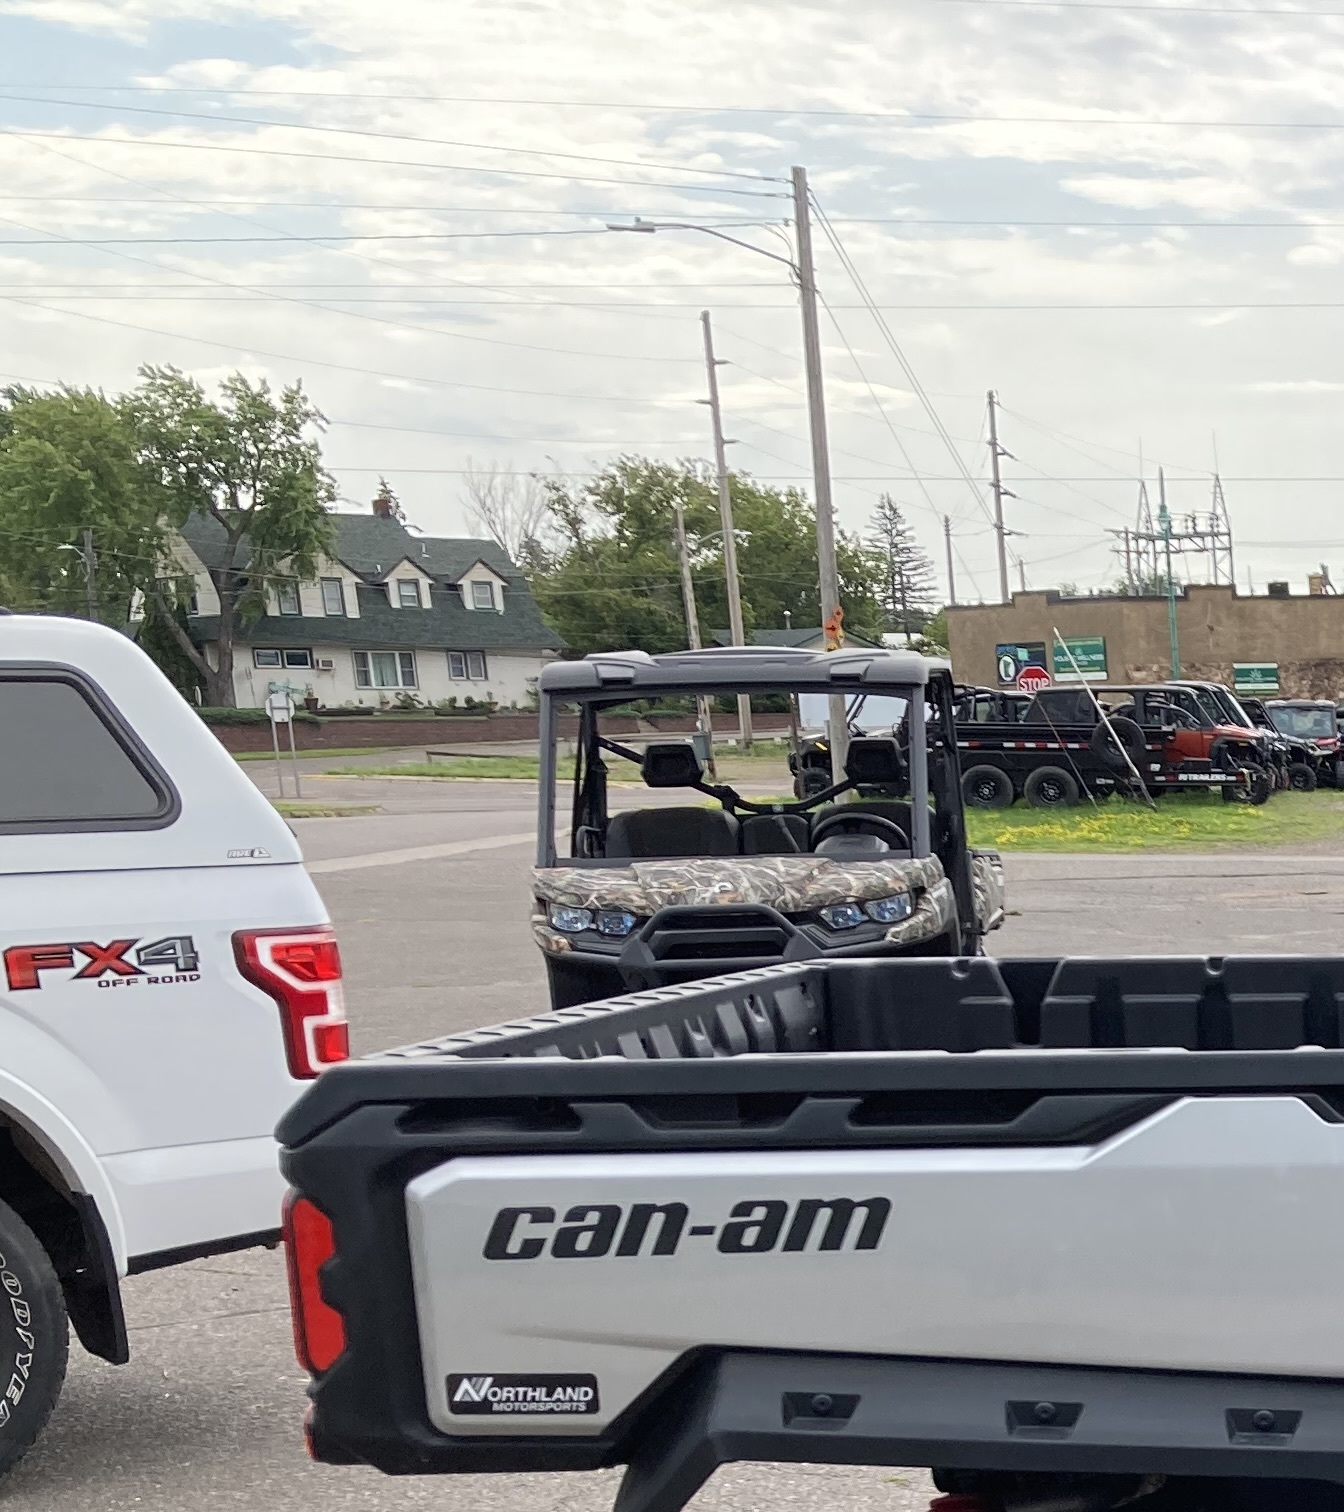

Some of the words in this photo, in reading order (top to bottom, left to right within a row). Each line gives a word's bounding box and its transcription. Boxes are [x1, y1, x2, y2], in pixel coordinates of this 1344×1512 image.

[1019, 677, 1049, 691] STOP
[3, 935, 201, 991] FX4
[97, 978, 139, 988] OFF
[147, 973, 201, 985] ROAD
[482, 1196, 893, 1261] can-am
[453, 1376, 594, 1402] NORTHLAND
[492, 1402, 587, 1412] MOTORSPORTS
